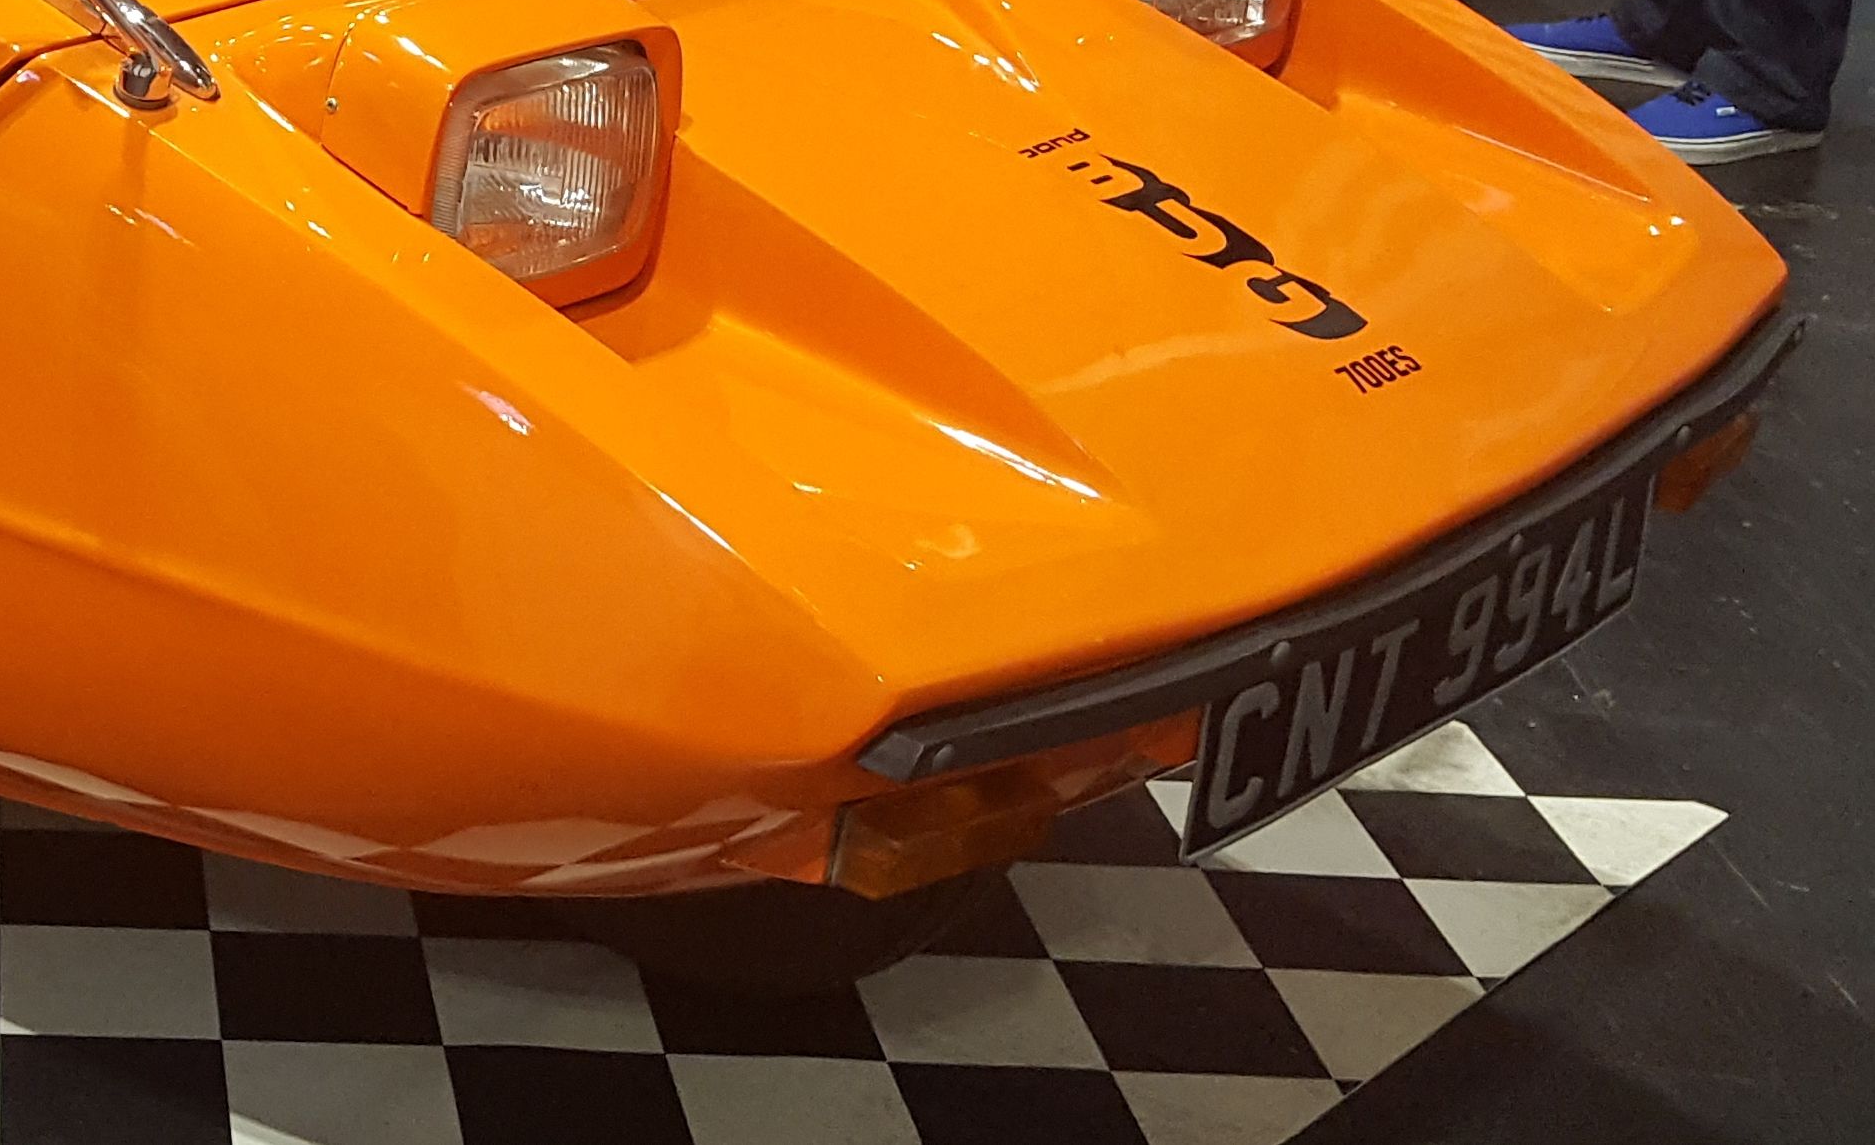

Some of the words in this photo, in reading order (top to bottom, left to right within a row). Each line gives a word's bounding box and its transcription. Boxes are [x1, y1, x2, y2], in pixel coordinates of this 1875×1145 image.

[1017, 127, 1091, 159] bond
[1066, 153, 1369, 341] BUG
[1333, 345, 1423, 395] 700ES
[1207, 618, 1421, 831] CNT
[1433, 496, 1636, 707] 994L
